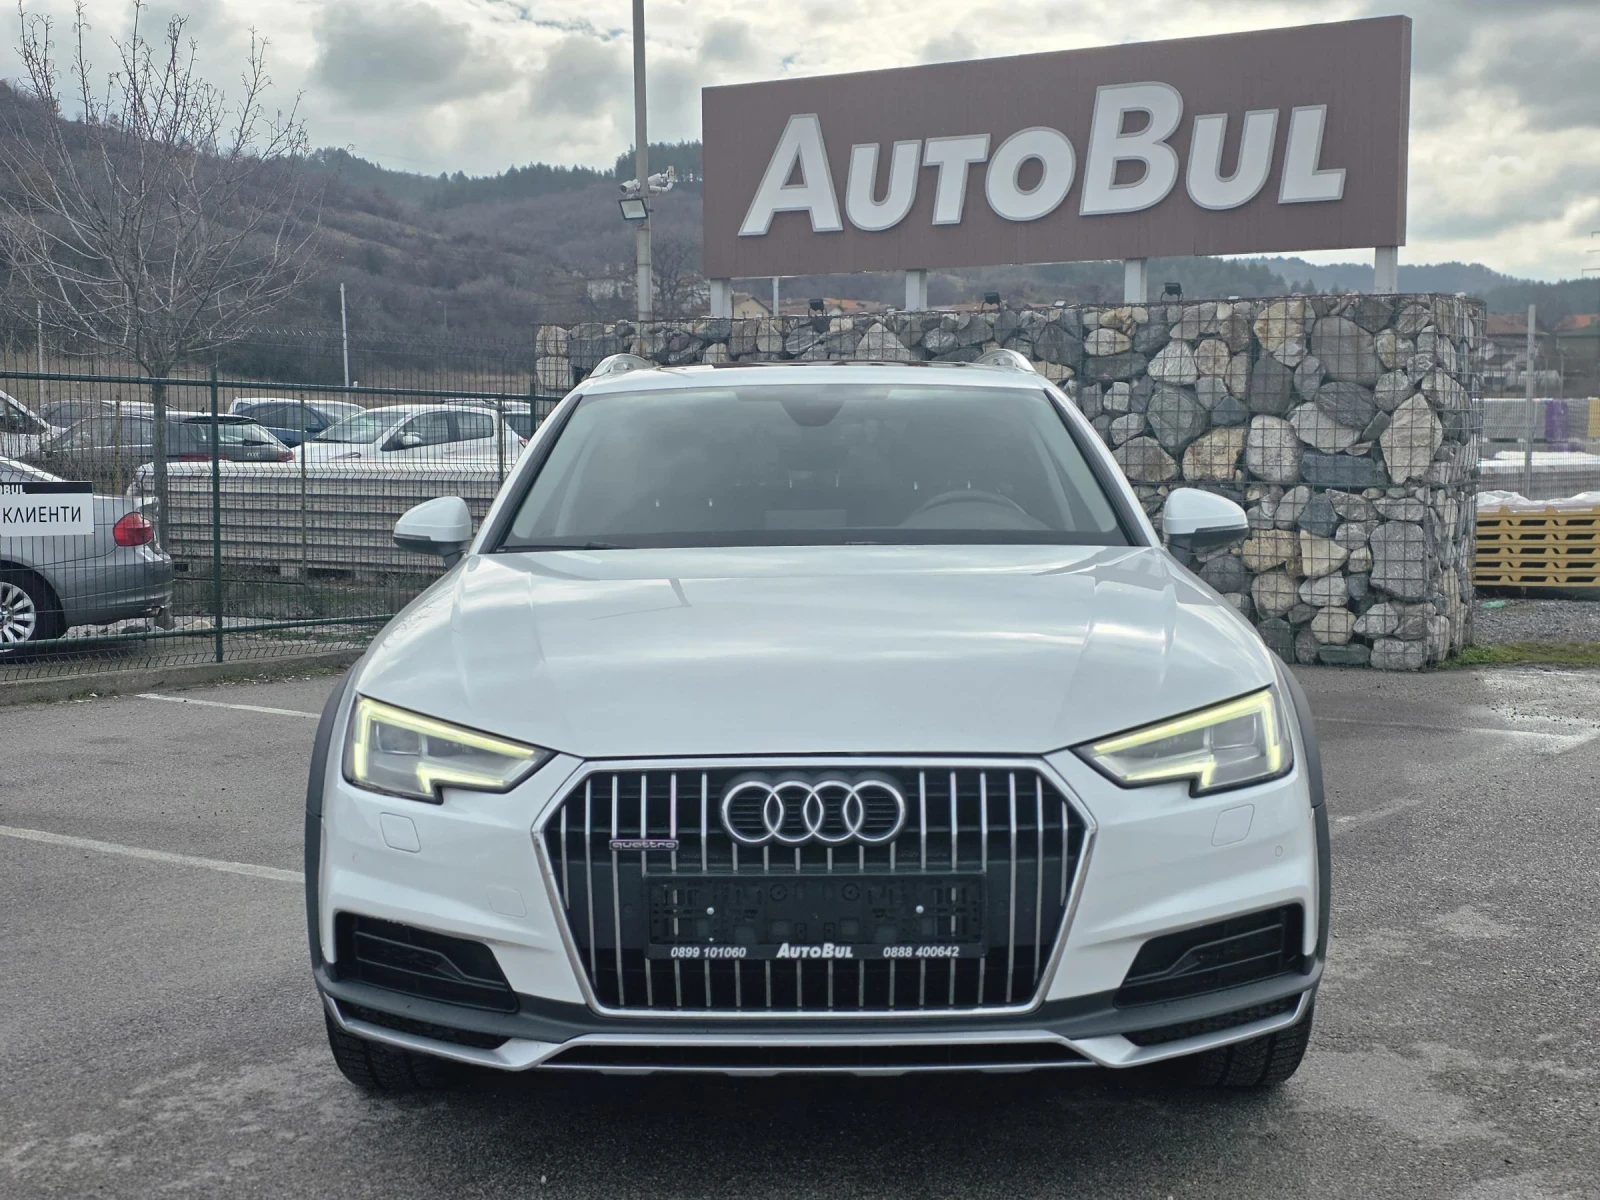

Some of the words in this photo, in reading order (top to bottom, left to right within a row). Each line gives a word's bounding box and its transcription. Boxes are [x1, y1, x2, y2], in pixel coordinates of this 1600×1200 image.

[0, 484, 26, 495] BUL
[2, 506, 81, 523] КЛИЕНТИ
[612, 841, 675, 849] quattro
[670, 947, 700, 958] 0899
[704, 947, 747, 958] 101060
[883, 946, 913, 958] 0888
[915, 945, 960, 957] 400642
